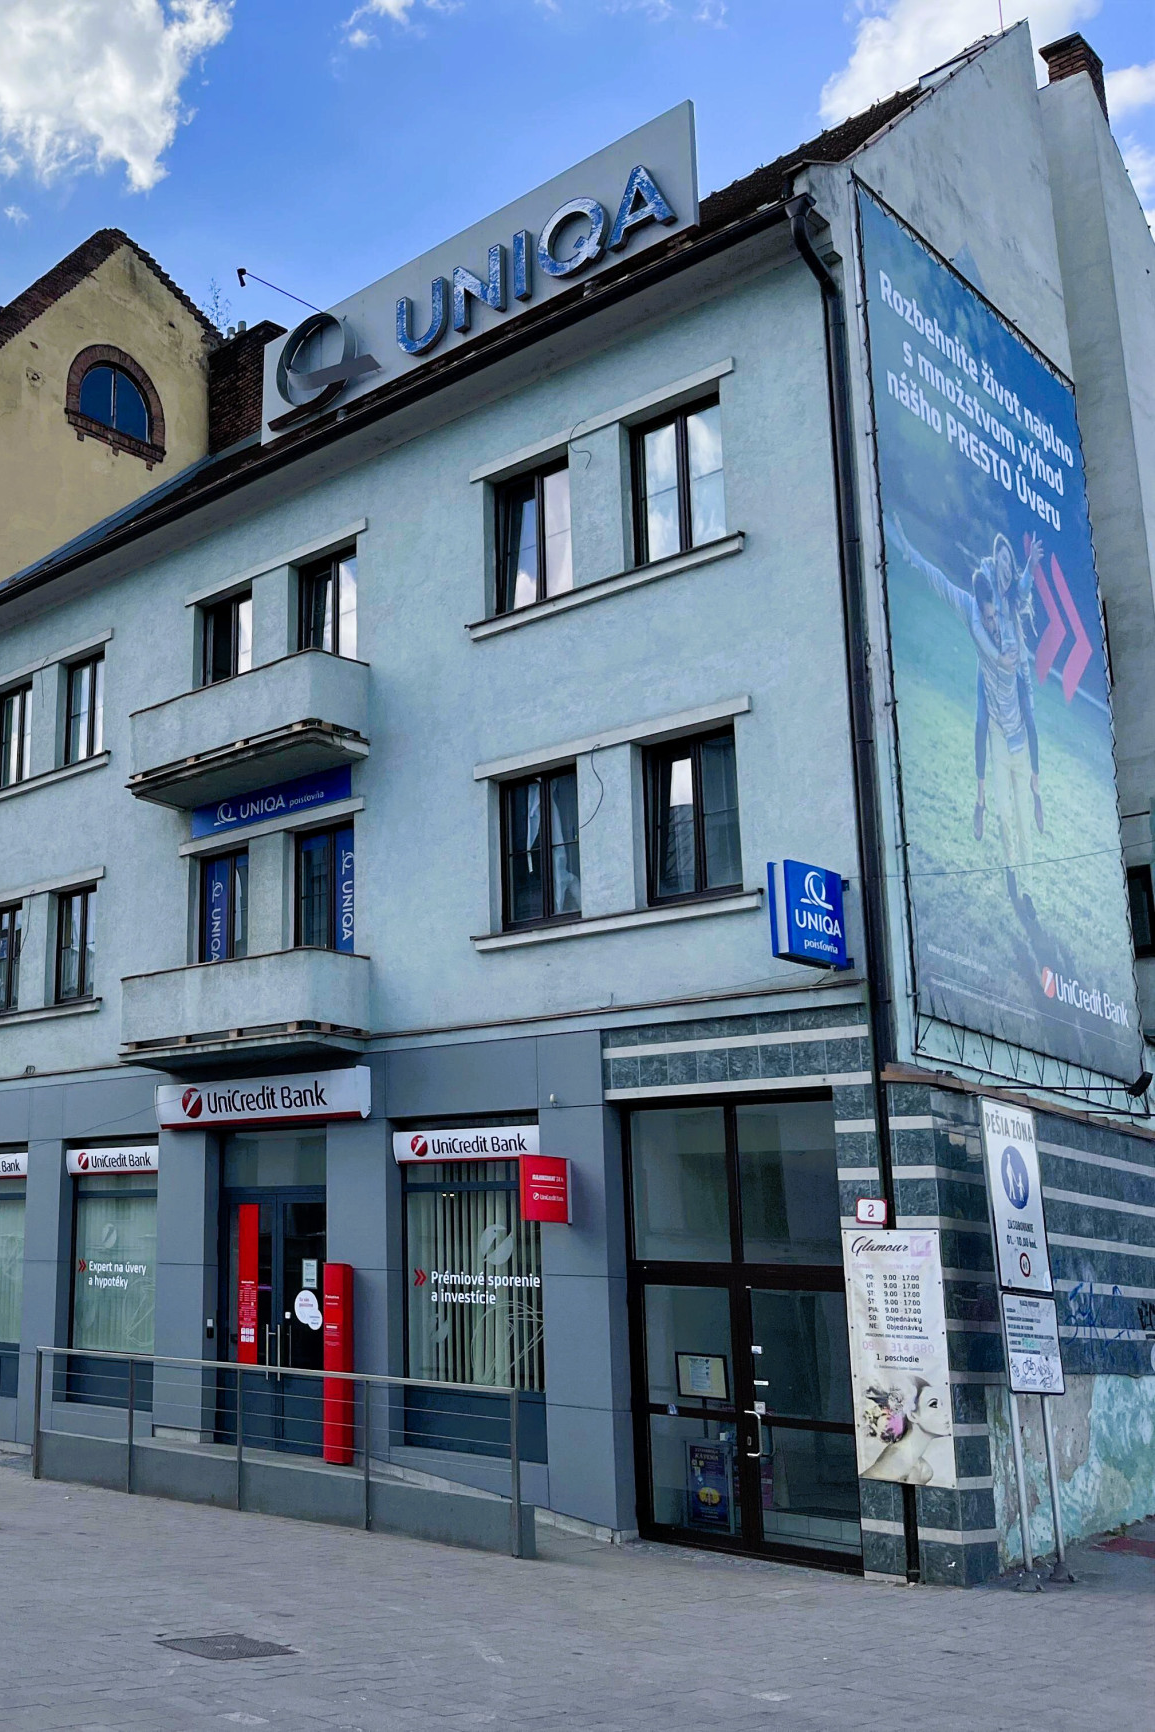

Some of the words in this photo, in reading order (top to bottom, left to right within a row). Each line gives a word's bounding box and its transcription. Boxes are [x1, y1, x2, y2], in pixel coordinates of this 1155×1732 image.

[396, 165, 677, 356] UNIQA
[879, 270, 979, 383] Rozbehnite
[981, 359, 1022, 422] život
[1024, 406, 1074, 468] naplno
[903, 341, 913, 368] s
[918, 352, 1016, 457] množstvom
[1018, 439, 1064, 496] výhod
[887, 369, 941, 434] nášho
[946, 412, 1012, 491] PRESTO
[1015, 465, 1061, 531] Úveru
[240, 794, 285, 819] UNIQA
[341, 880, 354, 941] UNIQA
[211, 907, 222, 962] UNIQA
[795, 909, 842, 938] UNIQA
[1055, 973, 1103, 1017] UniCredit
[1104, 993, 1130, 1028] Bank
[207, 1085, 278, 1114] UniCredit
[281, 1080, 328, 1108] Bank
[985, 1110, 1011, 1138] PEŠIA
[1011, 1116, 1034, 1144] ZÓNA
[431, 1136, 489, 1155] UniCredit
[491, 1133, 527, 1152] Bank
[1, 1158, 21, 1172] Bank
[91, 1153, 128, 1169] UniCredit
[128, 1152, 152, 1167] Bank
[867, 1204, 875, 1218] 2
[851, 1235, 909, 1257] Glamour
[88, 1260, 113, 1275] Expert
[114, 1262, 124, 1273] na
[125, 1261, 147, 1276] úvery
[88, 1278, 93, 1286] a
[94, 1275, 128, 1289] hypotéky
[431, 1270, 485, 1286] Prémiové
[487, 1273, 541, 1290] sporenie
[431, 1292, 438, 1302] a
[440, 1290, 496, 1305] investície
[885, 1315, 922, 1324] Objednávky
[886, 1323, 923, 1332] Objednávky
[884, 1354, 920, 1363] poschodie
